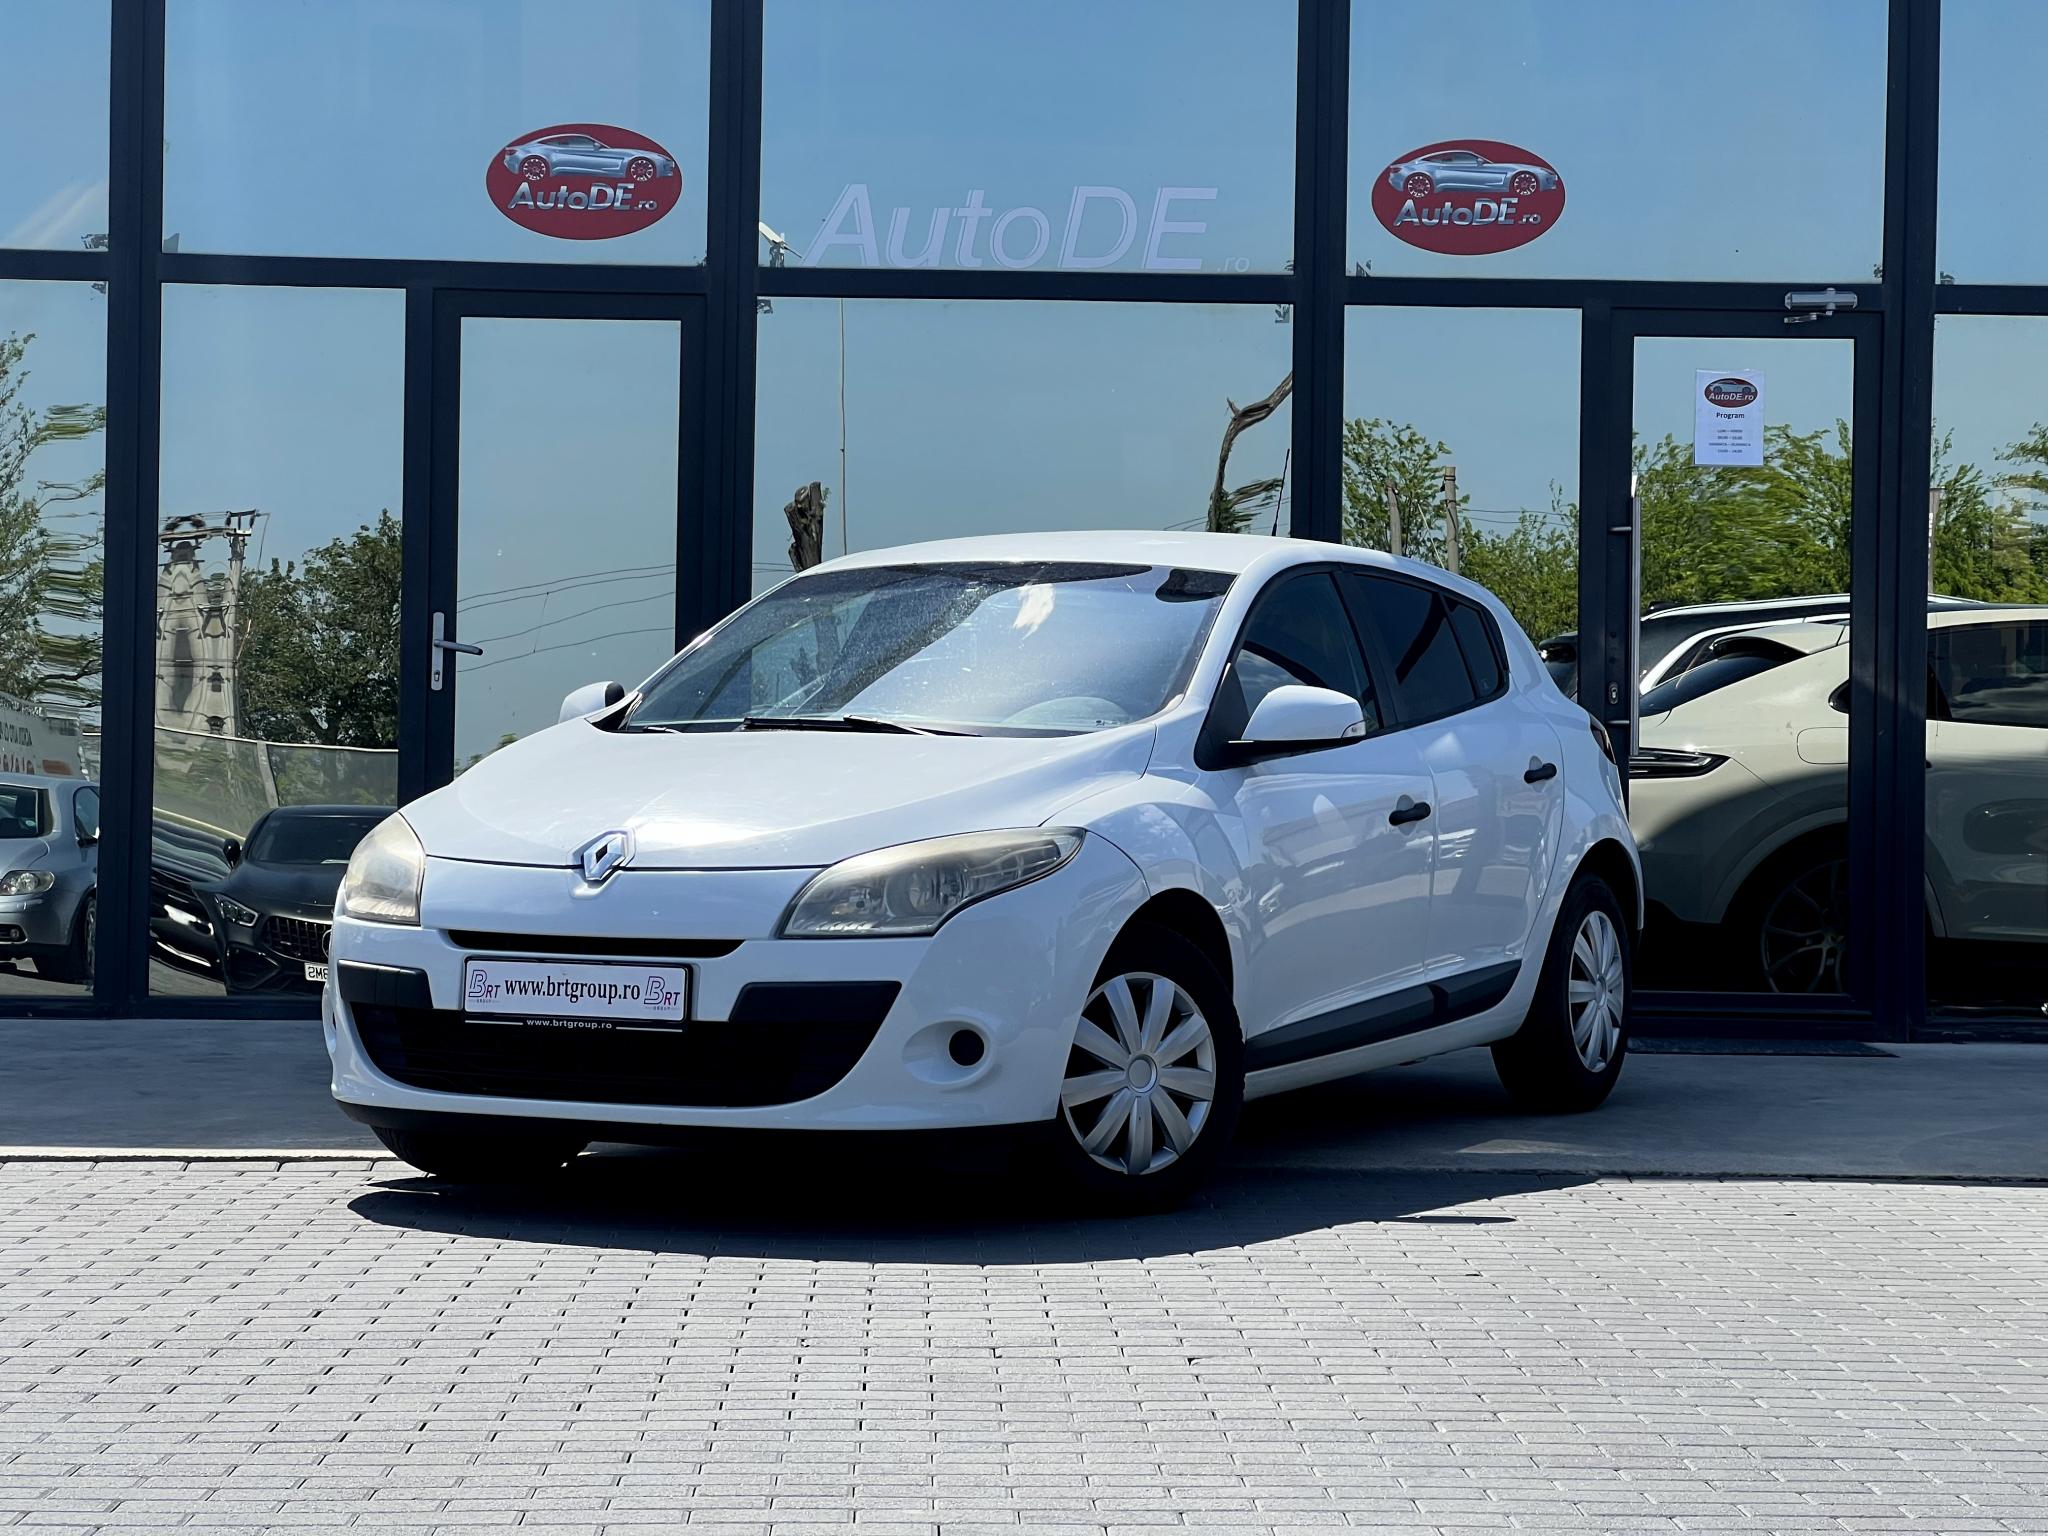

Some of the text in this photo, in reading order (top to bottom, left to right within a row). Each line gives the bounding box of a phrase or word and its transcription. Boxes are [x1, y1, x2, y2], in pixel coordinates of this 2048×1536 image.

[507, 181, 657, 211] AutoDE.ro
[1393, 197, 1541, 227] AutoDE.ro
[1716, 412, 1745, 420] Program
[504, 976, 641, 1004] www.brtgroup.ro
[526, 1018, 613, 1029] www.brtgroup.ro
